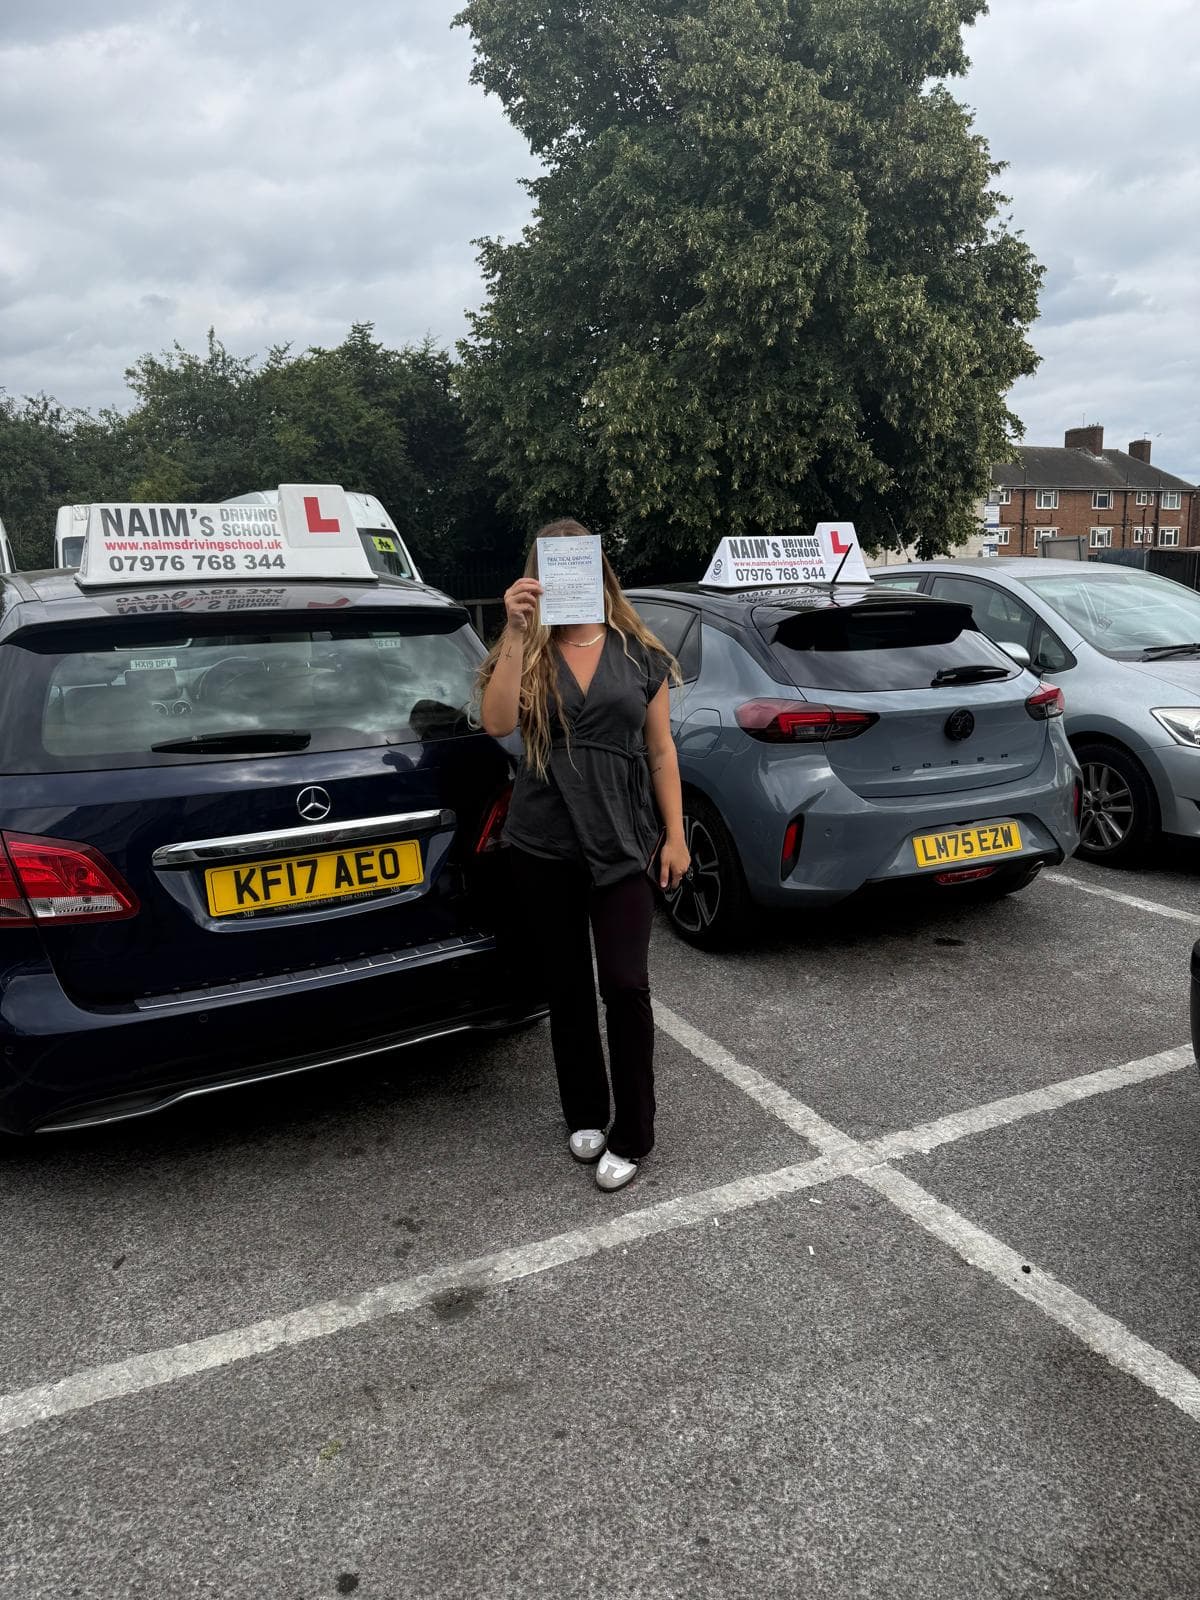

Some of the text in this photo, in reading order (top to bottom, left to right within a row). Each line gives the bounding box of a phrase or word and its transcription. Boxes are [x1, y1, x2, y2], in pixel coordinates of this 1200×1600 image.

[219, 508, 278, 522] DRIVING
[303, 496, 341, 533] L
[222, 523, 281, 537] SCHOOL
[782, 538, 819, 548] DRIVING
[830, 530, 851, 554] L
[785, 548, 821, 558] SCHOOL
[109, 553, 286, 572] 07976 768 344
[735, 566, 826, 581] 07976 768 344
[921, 826, 1014, 862] LM75 EZW
[233, 847, 401, 905] KF17 AEO
